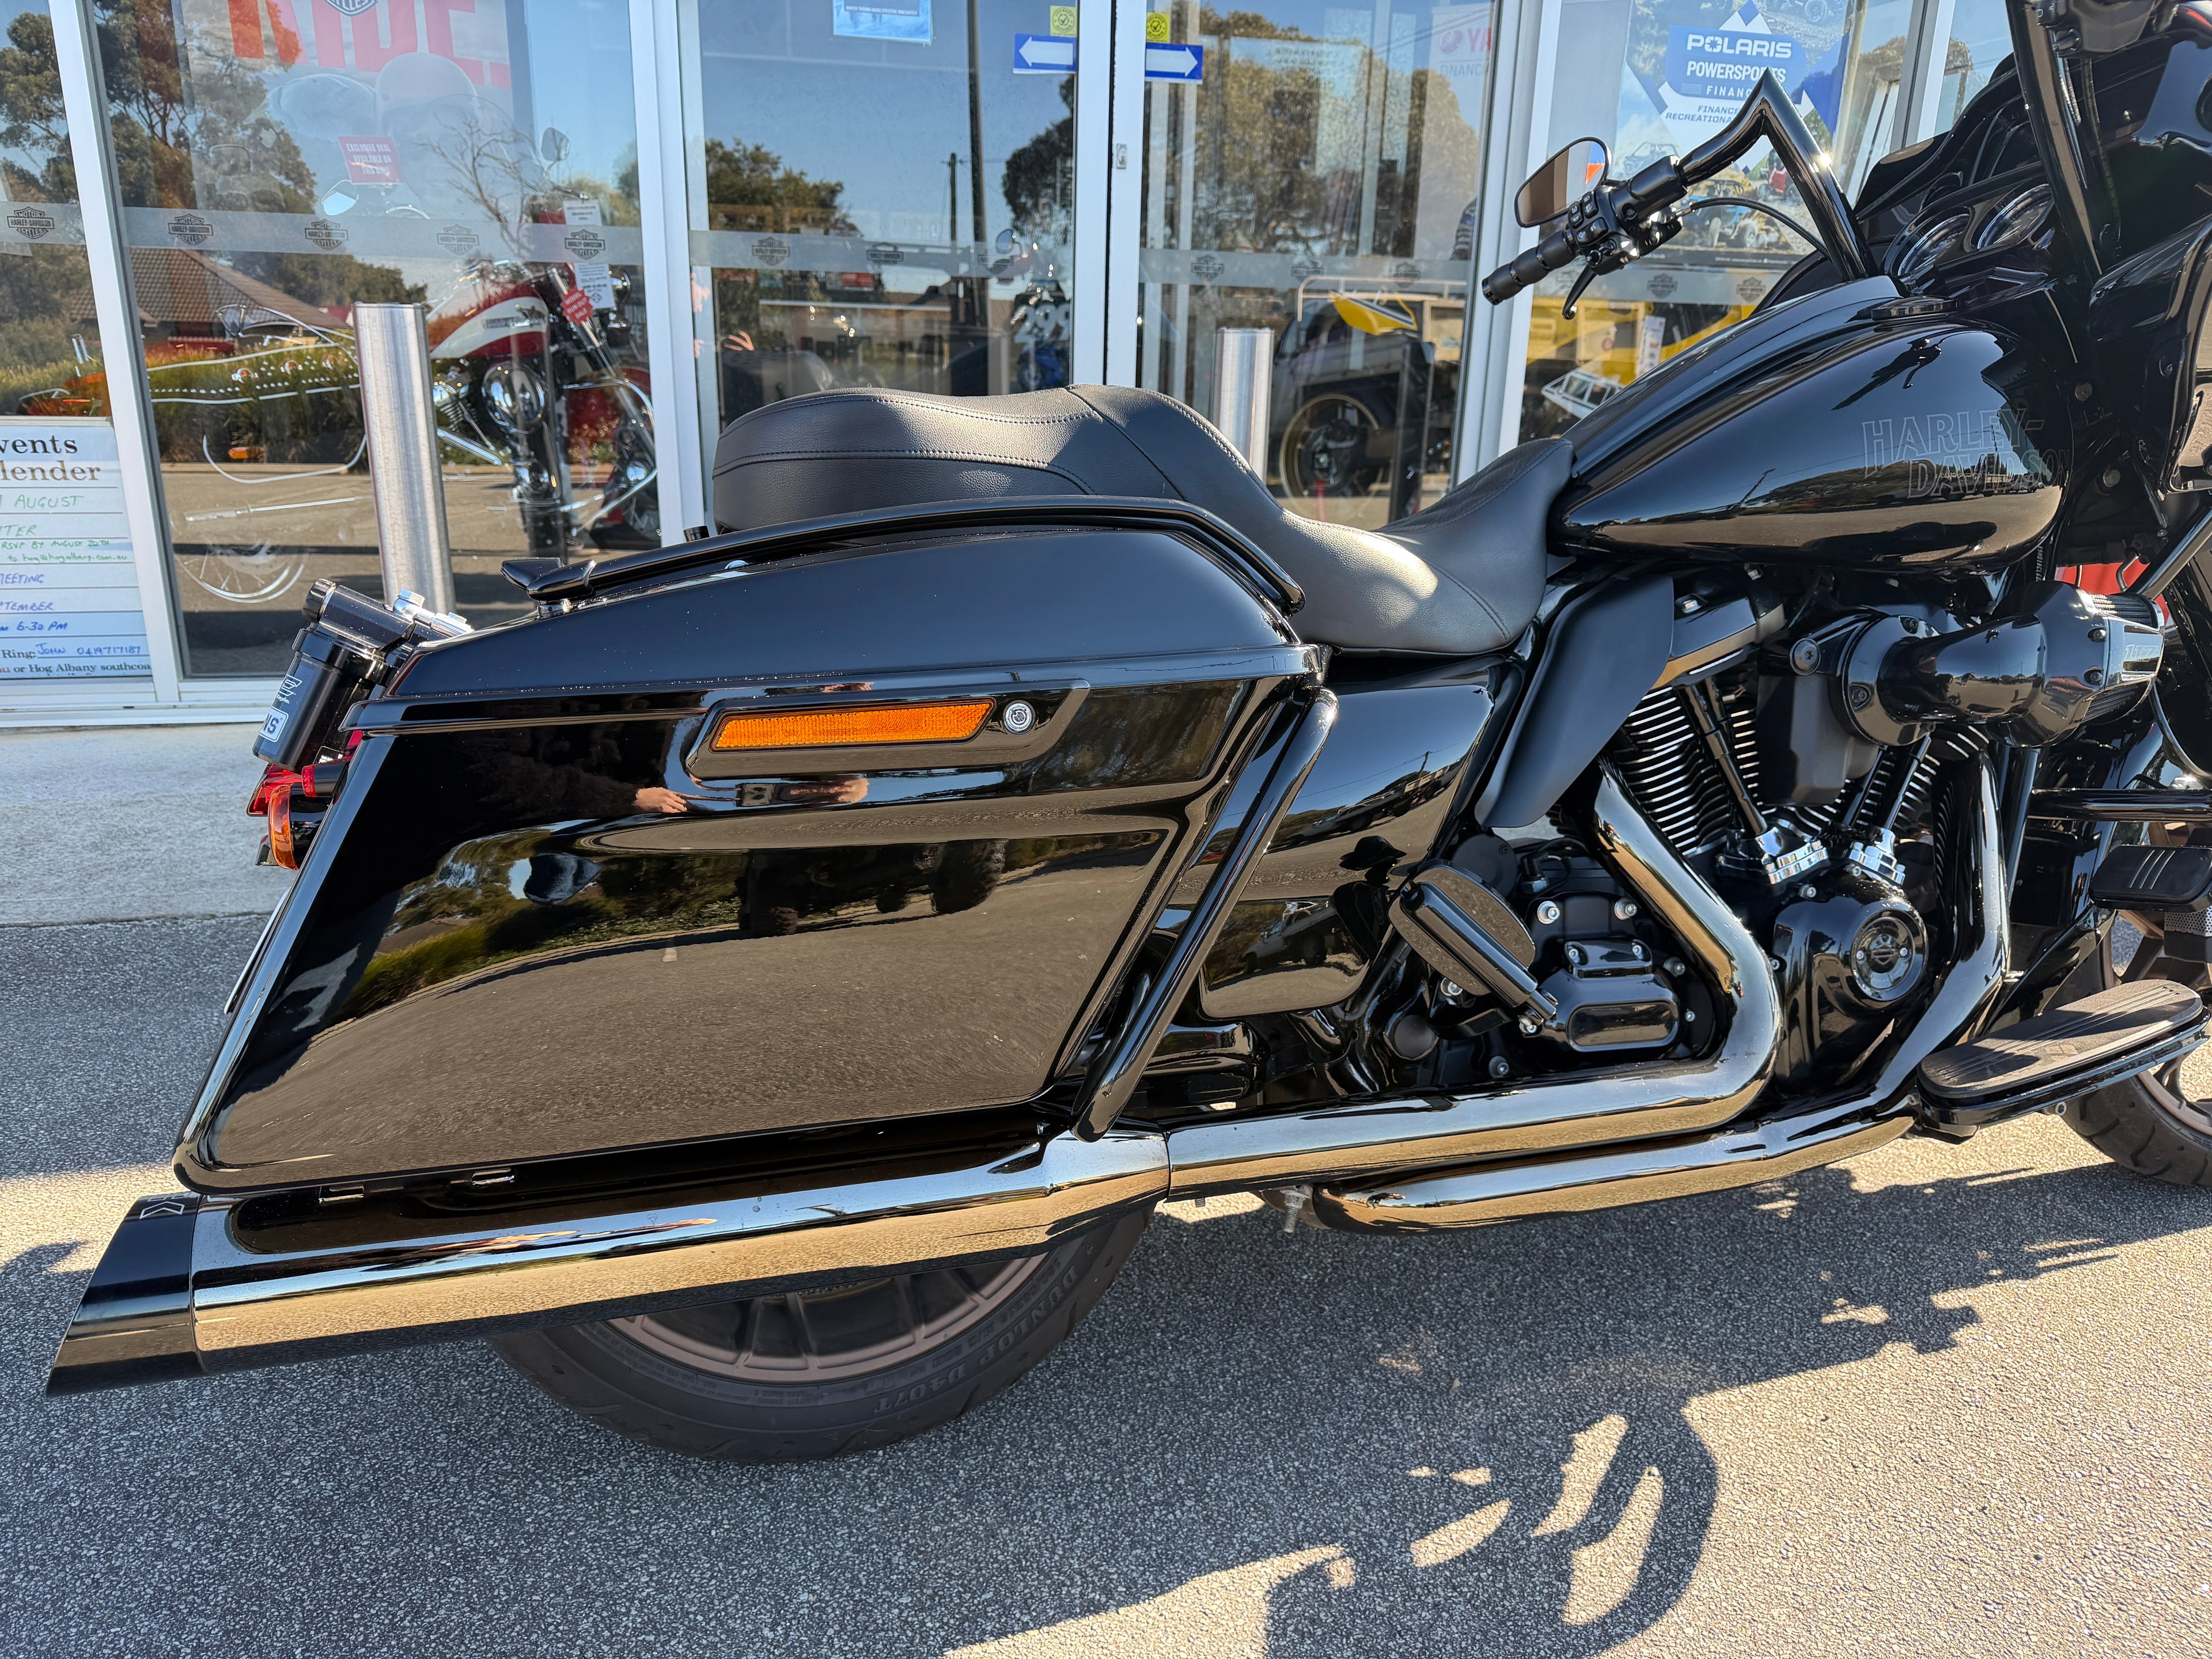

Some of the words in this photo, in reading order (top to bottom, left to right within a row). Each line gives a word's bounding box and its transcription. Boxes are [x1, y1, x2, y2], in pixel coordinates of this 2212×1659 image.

[1687, 34, 1792, 58] POLARIS
[1862, 408, 2045, 479] HARLEY-
[1907, 448, 2071, 499] DAVIDSON
[14, 494, 84, 508] AUGUST
[2, 541, 25, 550] RSVP
[2, 649, 36, 660] Ring:
[35, 642, 66, 655] JOHN
[2124, 645, 2158, 662] 117
[29, 664, 52, 674] Hog
[56, 662, 96, 673] Albany
[979, 1266, 1078, 1365] DUNLOP
[873, 1361, 967, 1414] D407T
